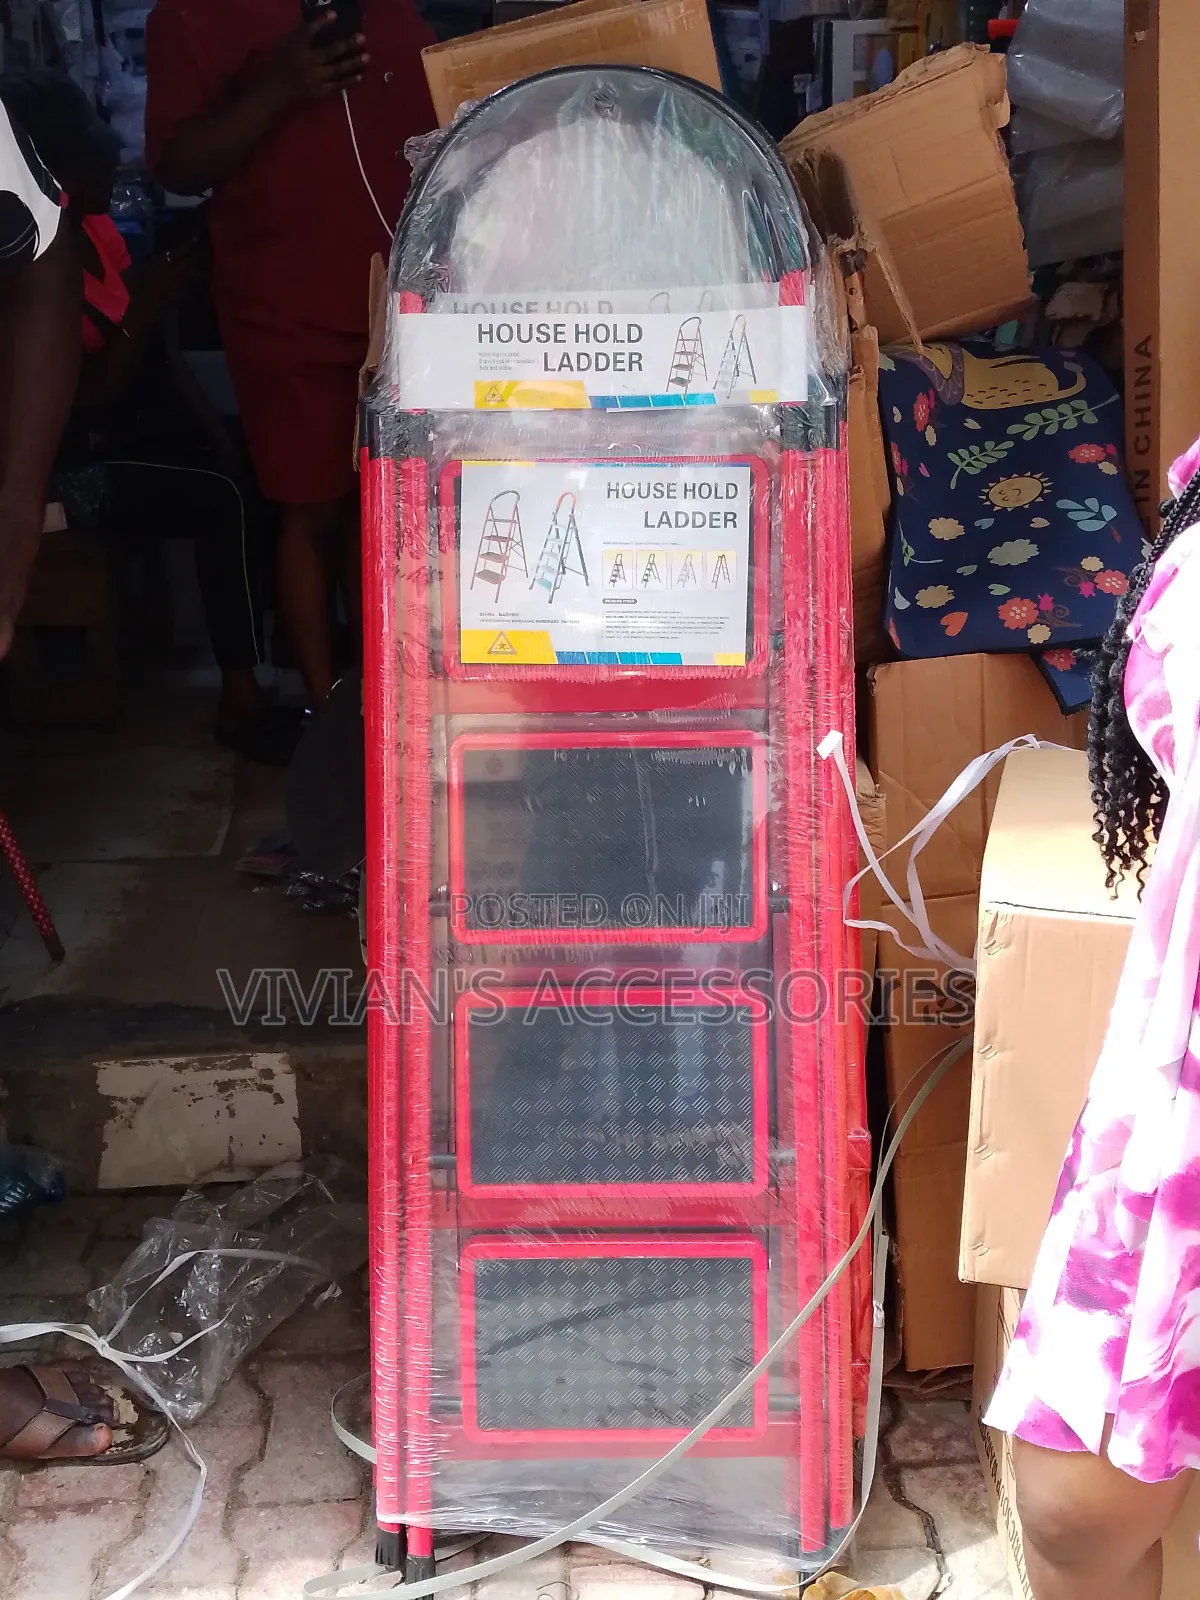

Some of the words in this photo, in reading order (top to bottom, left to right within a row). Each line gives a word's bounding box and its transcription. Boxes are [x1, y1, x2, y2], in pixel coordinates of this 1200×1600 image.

[477, 323, 567, 344] HOUSE
[574, 323, 644, 344] HOLD
[543, 352, 644, 373] LADDER
[1134, 334, 1153, 456] CHINA
[606, 482, 677, 500] HOUSE
[683, 482, 739, 500] HOLD
[1135, 469, 1151, 505] IN
[644, 511, 738, 529] LADDER
